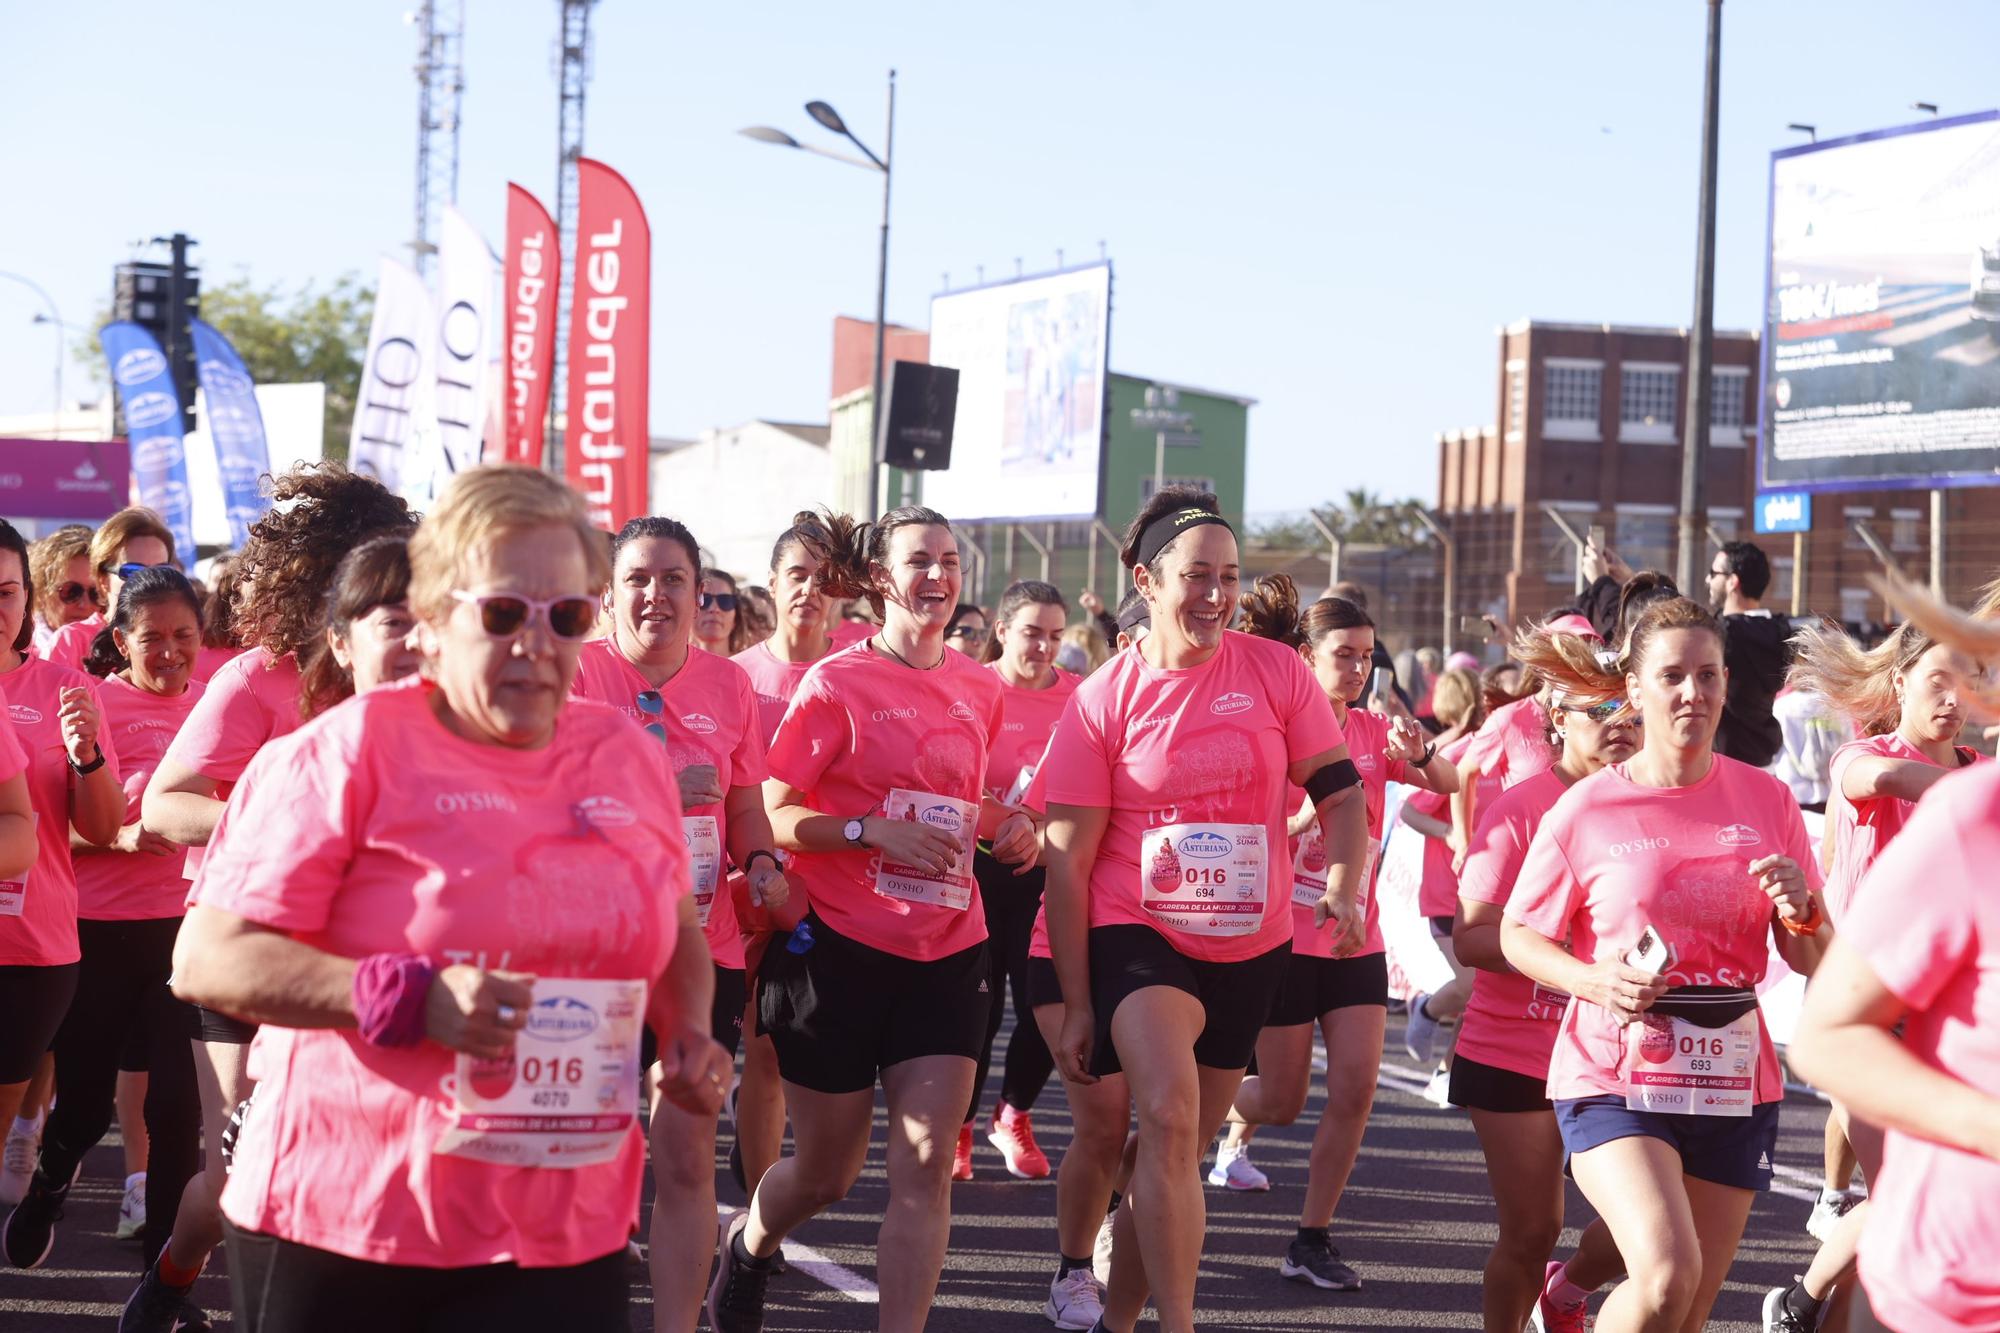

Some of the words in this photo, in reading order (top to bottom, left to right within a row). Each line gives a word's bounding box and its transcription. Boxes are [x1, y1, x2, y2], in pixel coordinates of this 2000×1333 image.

[872, 707, 917, 722] OYSHO
[1183, 842, 1228, 852] ASTURIANA
[1609, 837, 1670, 857] OYSHO
[1185, 868, 1226, 884] 016
[887, 880, 924, 894] OYSHO
[1195, 888, 1215, 897] 694
[1679, 1037, 1723, 1055] 016
[522, 1057, 582, 1083] 016
[1690, 1059, 1711, 1071] 693
[1641, 1091, 1684, 1105] OYSHO
